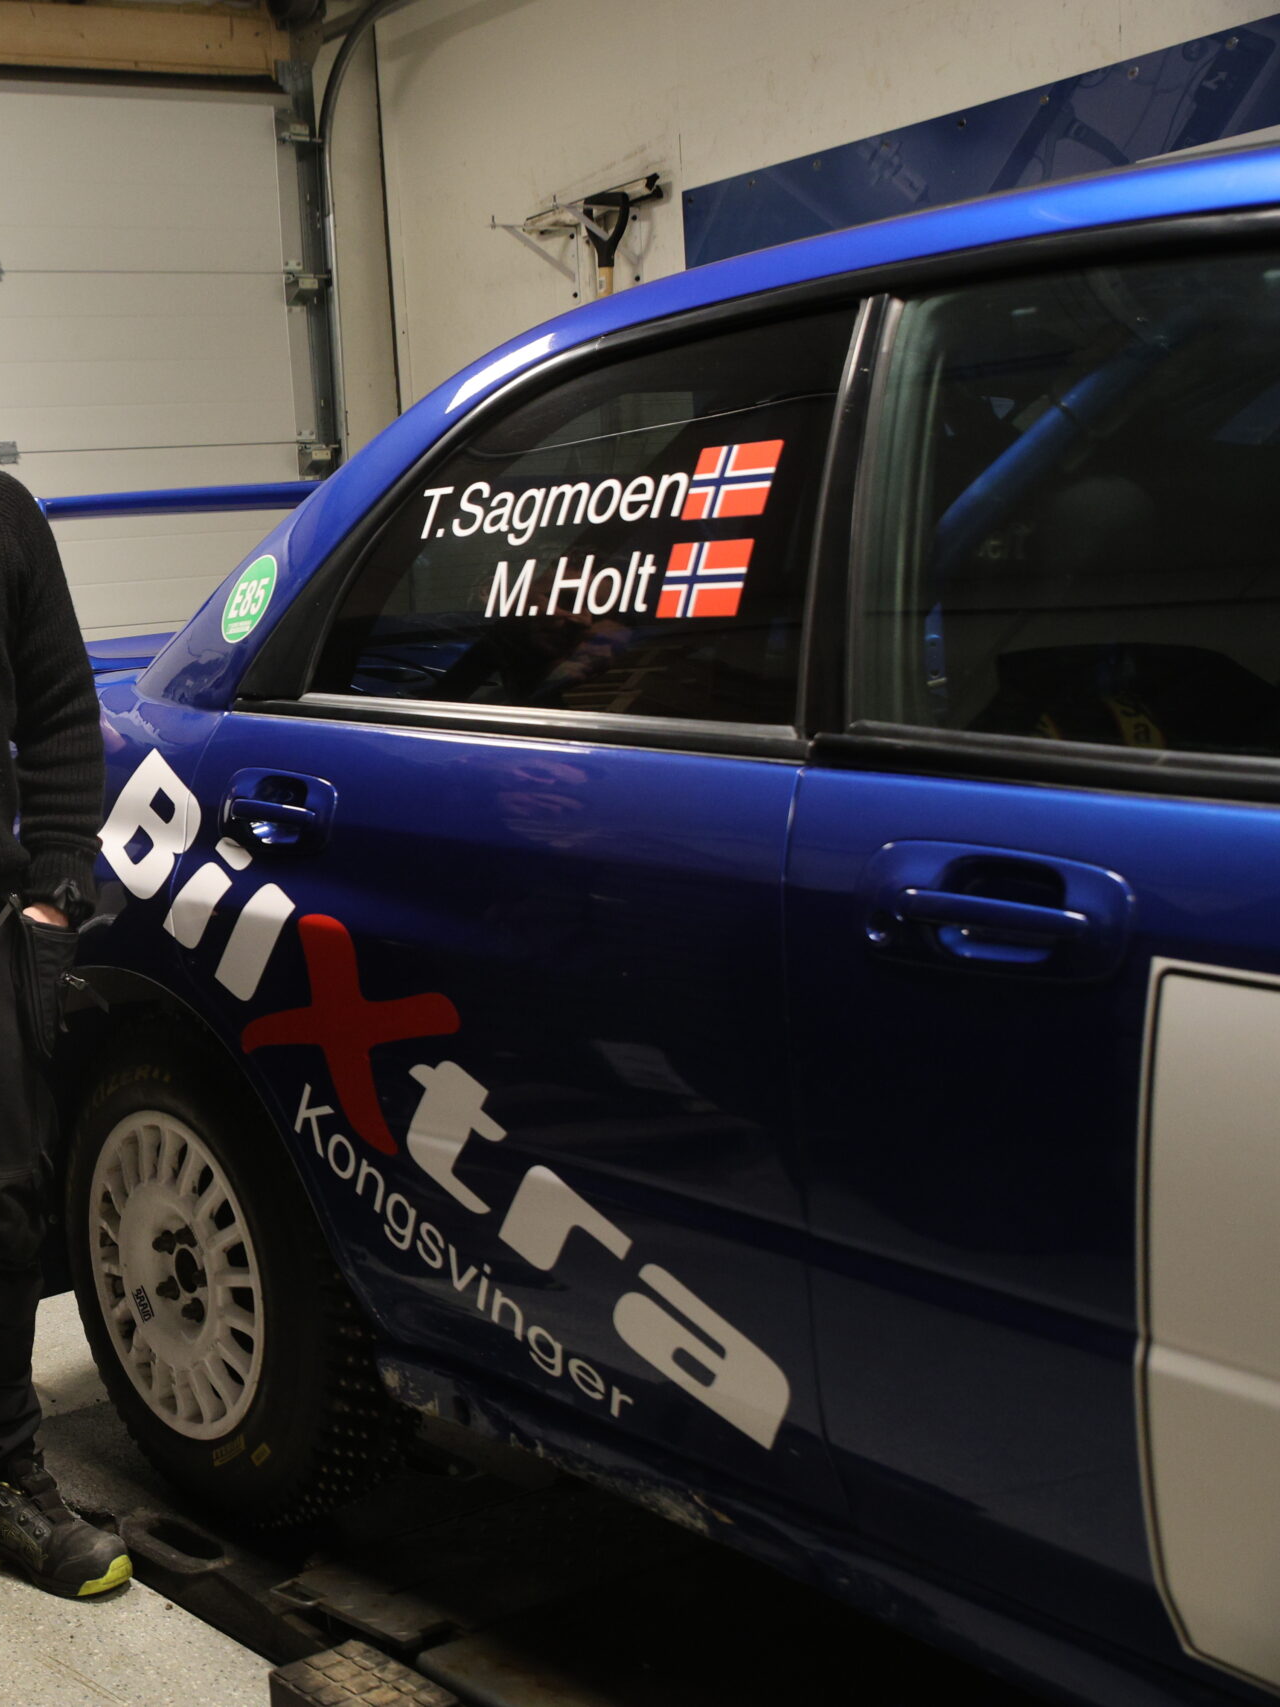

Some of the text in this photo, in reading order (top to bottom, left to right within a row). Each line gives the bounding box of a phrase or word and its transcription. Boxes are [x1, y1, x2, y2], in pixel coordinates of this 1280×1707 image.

[421, 473, 691, 547] T.Sagmoen
[228, 578, 269, 618] E85
[484, 550, 657, 618] M.Holt
[294, 1083, 634, 1419] Kongsvinger
[134, 1288, 152, 1322] BRAID
